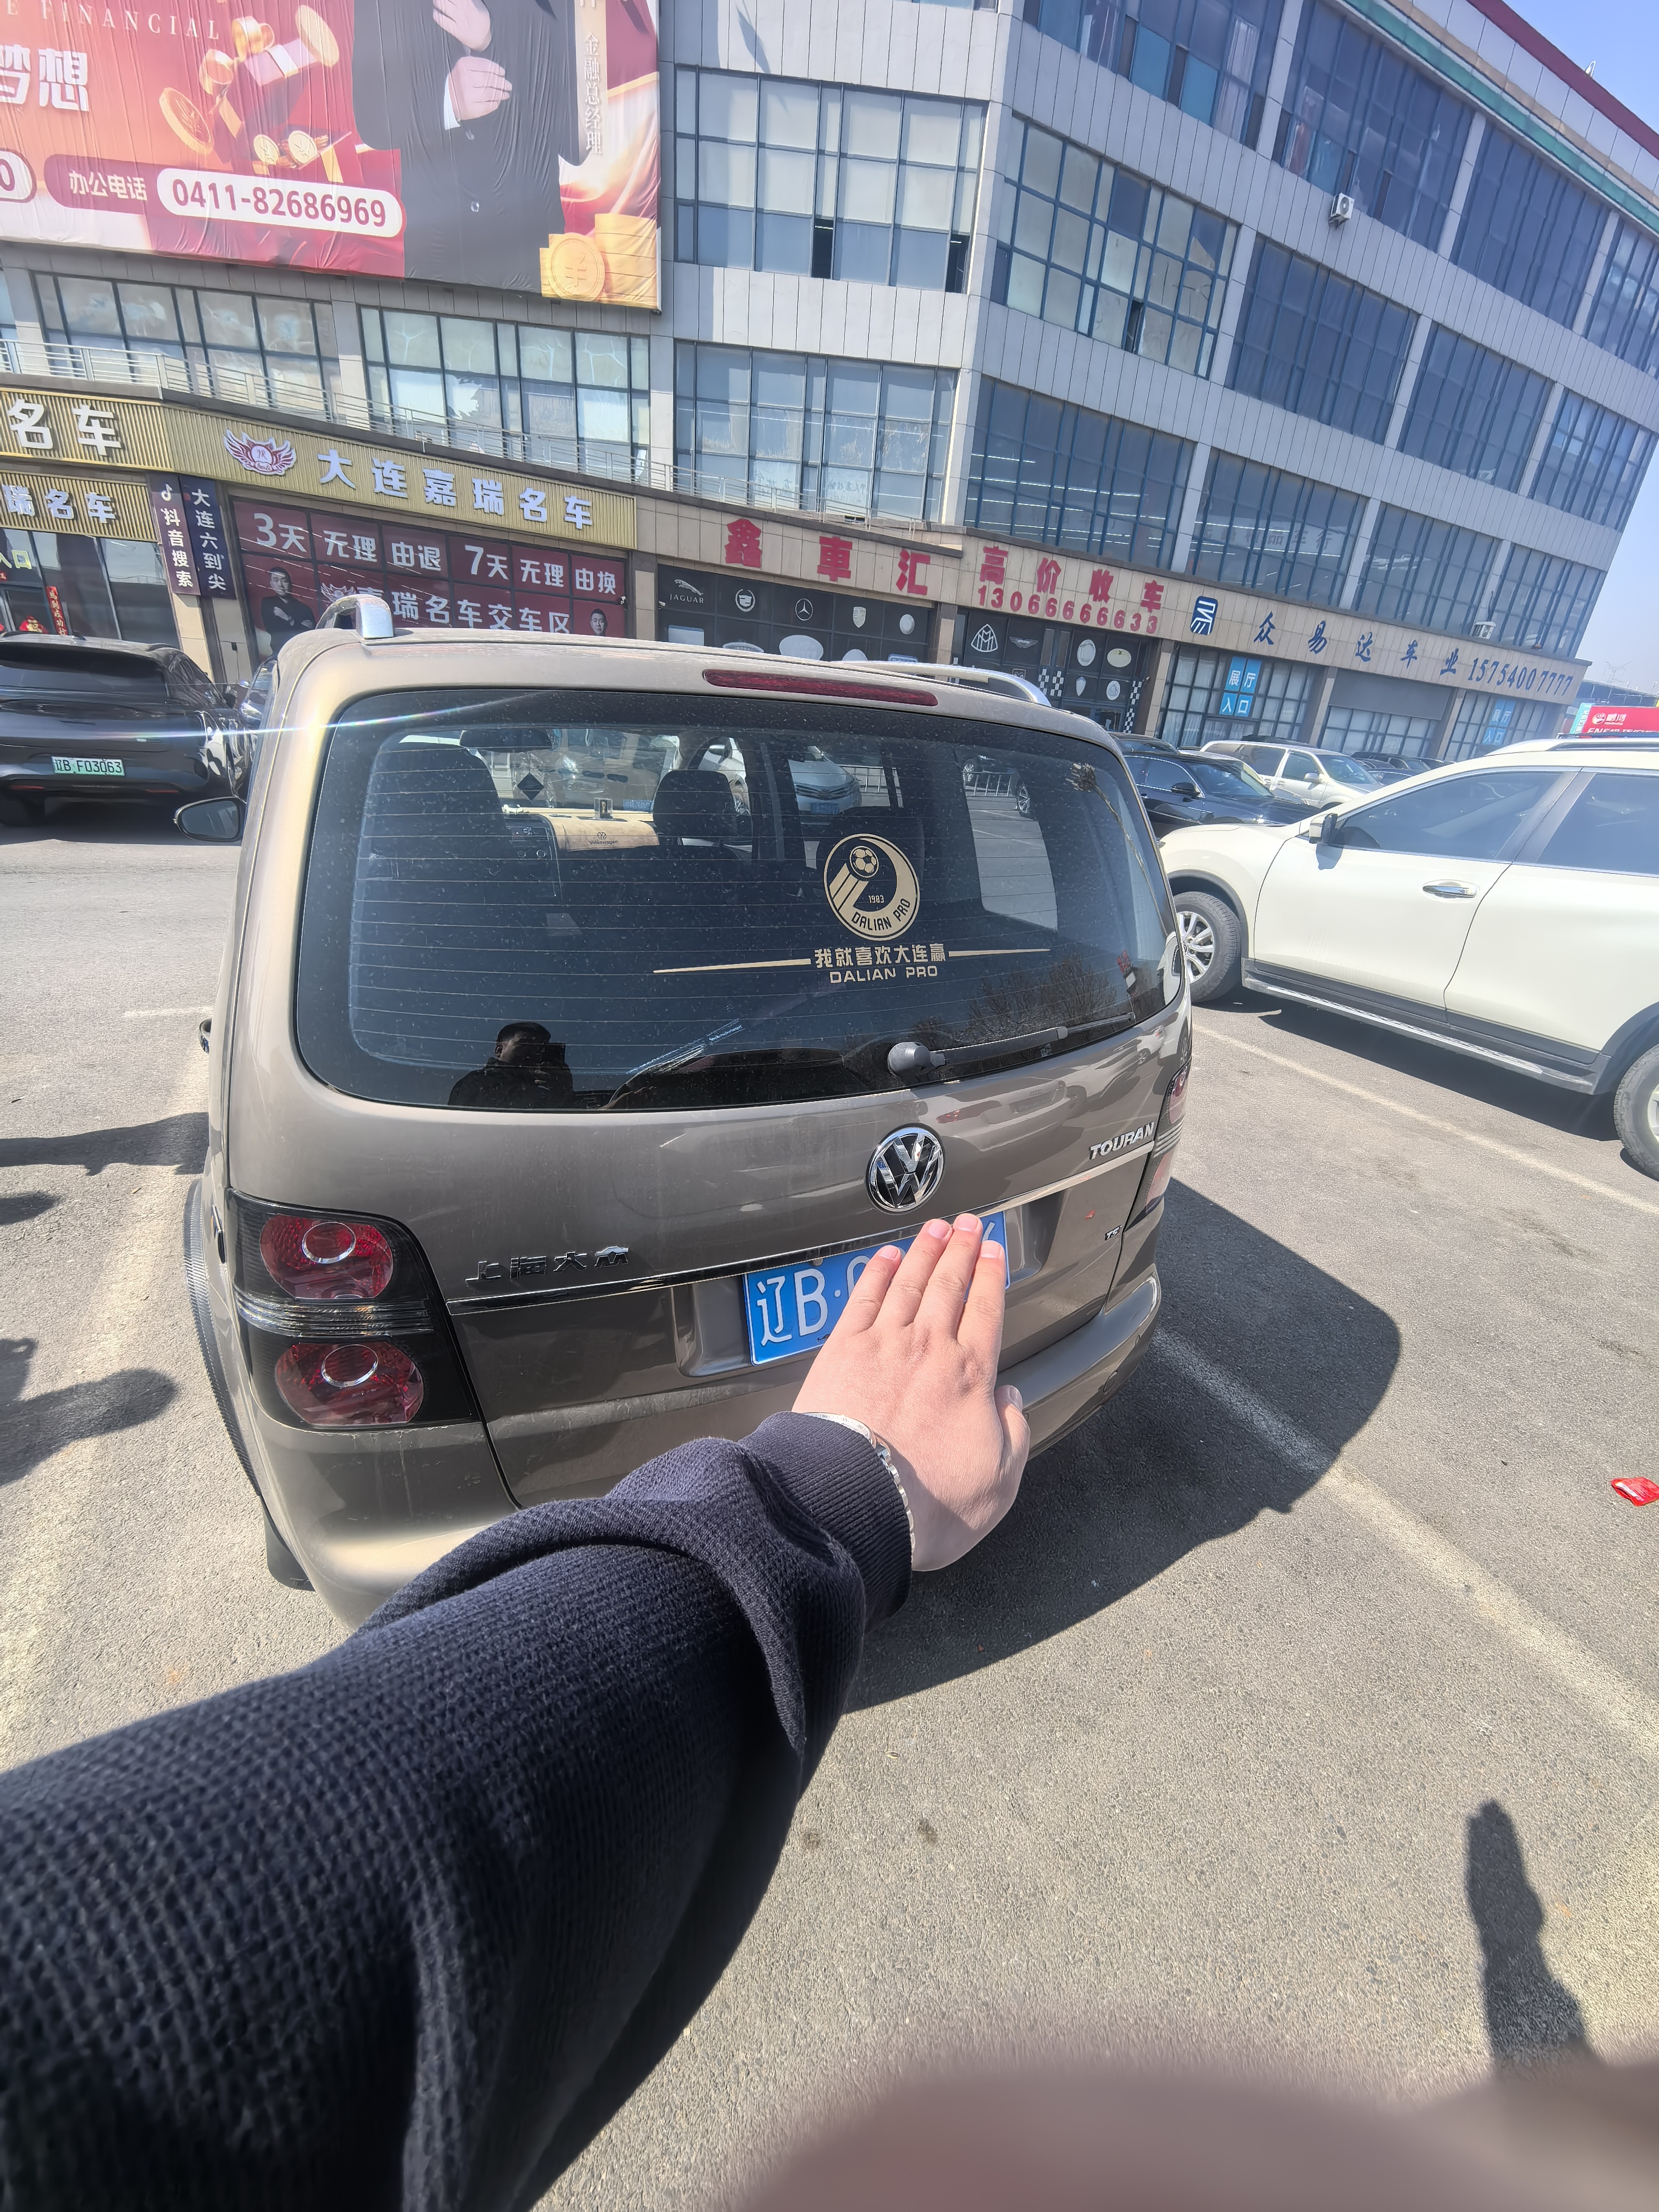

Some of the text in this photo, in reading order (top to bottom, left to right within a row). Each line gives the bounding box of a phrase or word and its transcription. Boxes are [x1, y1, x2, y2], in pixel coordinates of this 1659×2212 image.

[41, 0, 219, 40] FINANCIAL
[583, 32, 602, 155] 金融总经理
[69, 170, 147, 201] 办公电话
[172, 179, 386, 228] 0411-82686969
[9, 398, 121, 456] 名车
[1, 484, 116, 524] 瑞名车
[317, 449, 594, 530] 大连嘉瑞名车
[160, 508, 193, 588] 抖音搜索
[191, 489, 227, 591] 大连六到尖
[670, 593, 704, 604] JAGUAR
[979, 546, 1165, 612] 高价收车
[977, 585, 1158, 634] 13066666633
[1253, 611, 1459, 675] 众易达车业
[1228, 670, 1256, 688] 展厅
[1467, 658, 1574, 696] 15754007777
[1222, 697, 1249, 714] 入口
[851, 898, 911, 931] DALIAN PRO
[868, 895, 885, 903] 1983
[814, 943, 946, 968] 我就喜欢大连赢
[830, 965, 938, 984] DALIAN PRO
[1090, 1122, 1155, 1160] TOURAN
